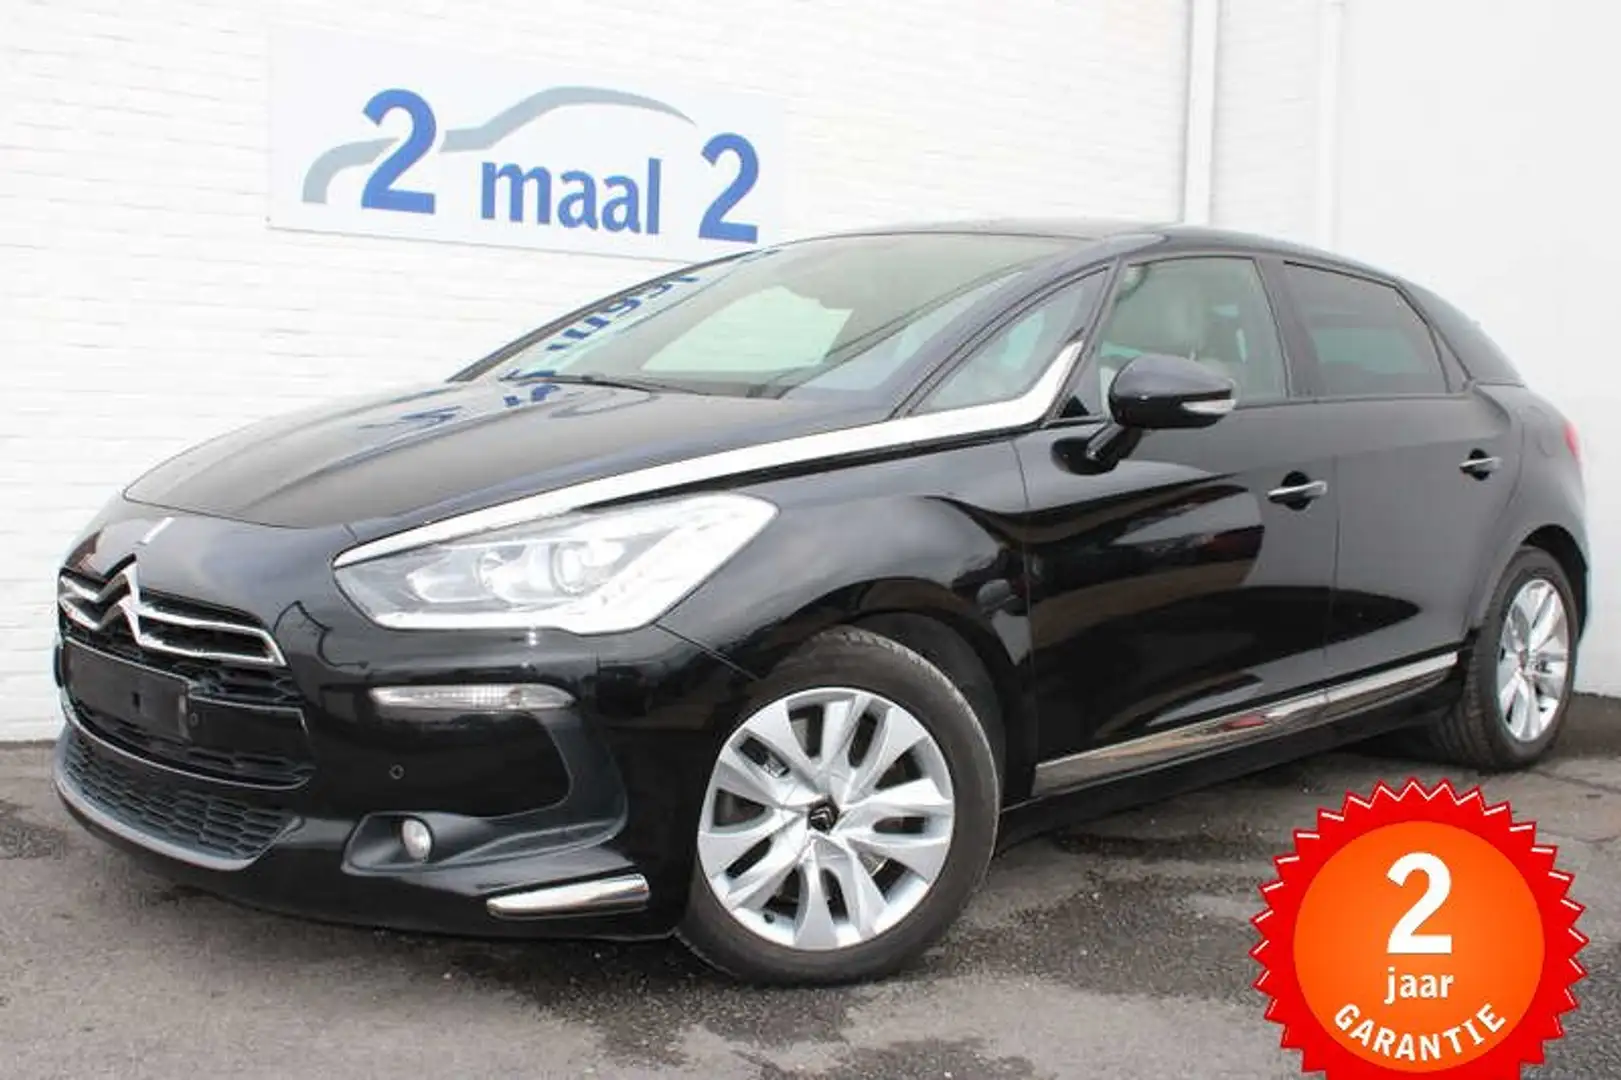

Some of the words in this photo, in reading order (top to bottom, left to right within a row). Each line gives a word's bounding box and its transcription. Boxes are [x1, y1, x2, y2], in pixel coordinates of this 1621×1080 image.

[361, 88, 436, 214] 2
[481, 157, 661, 234] maal
[698, 132, 759, 243] 2
